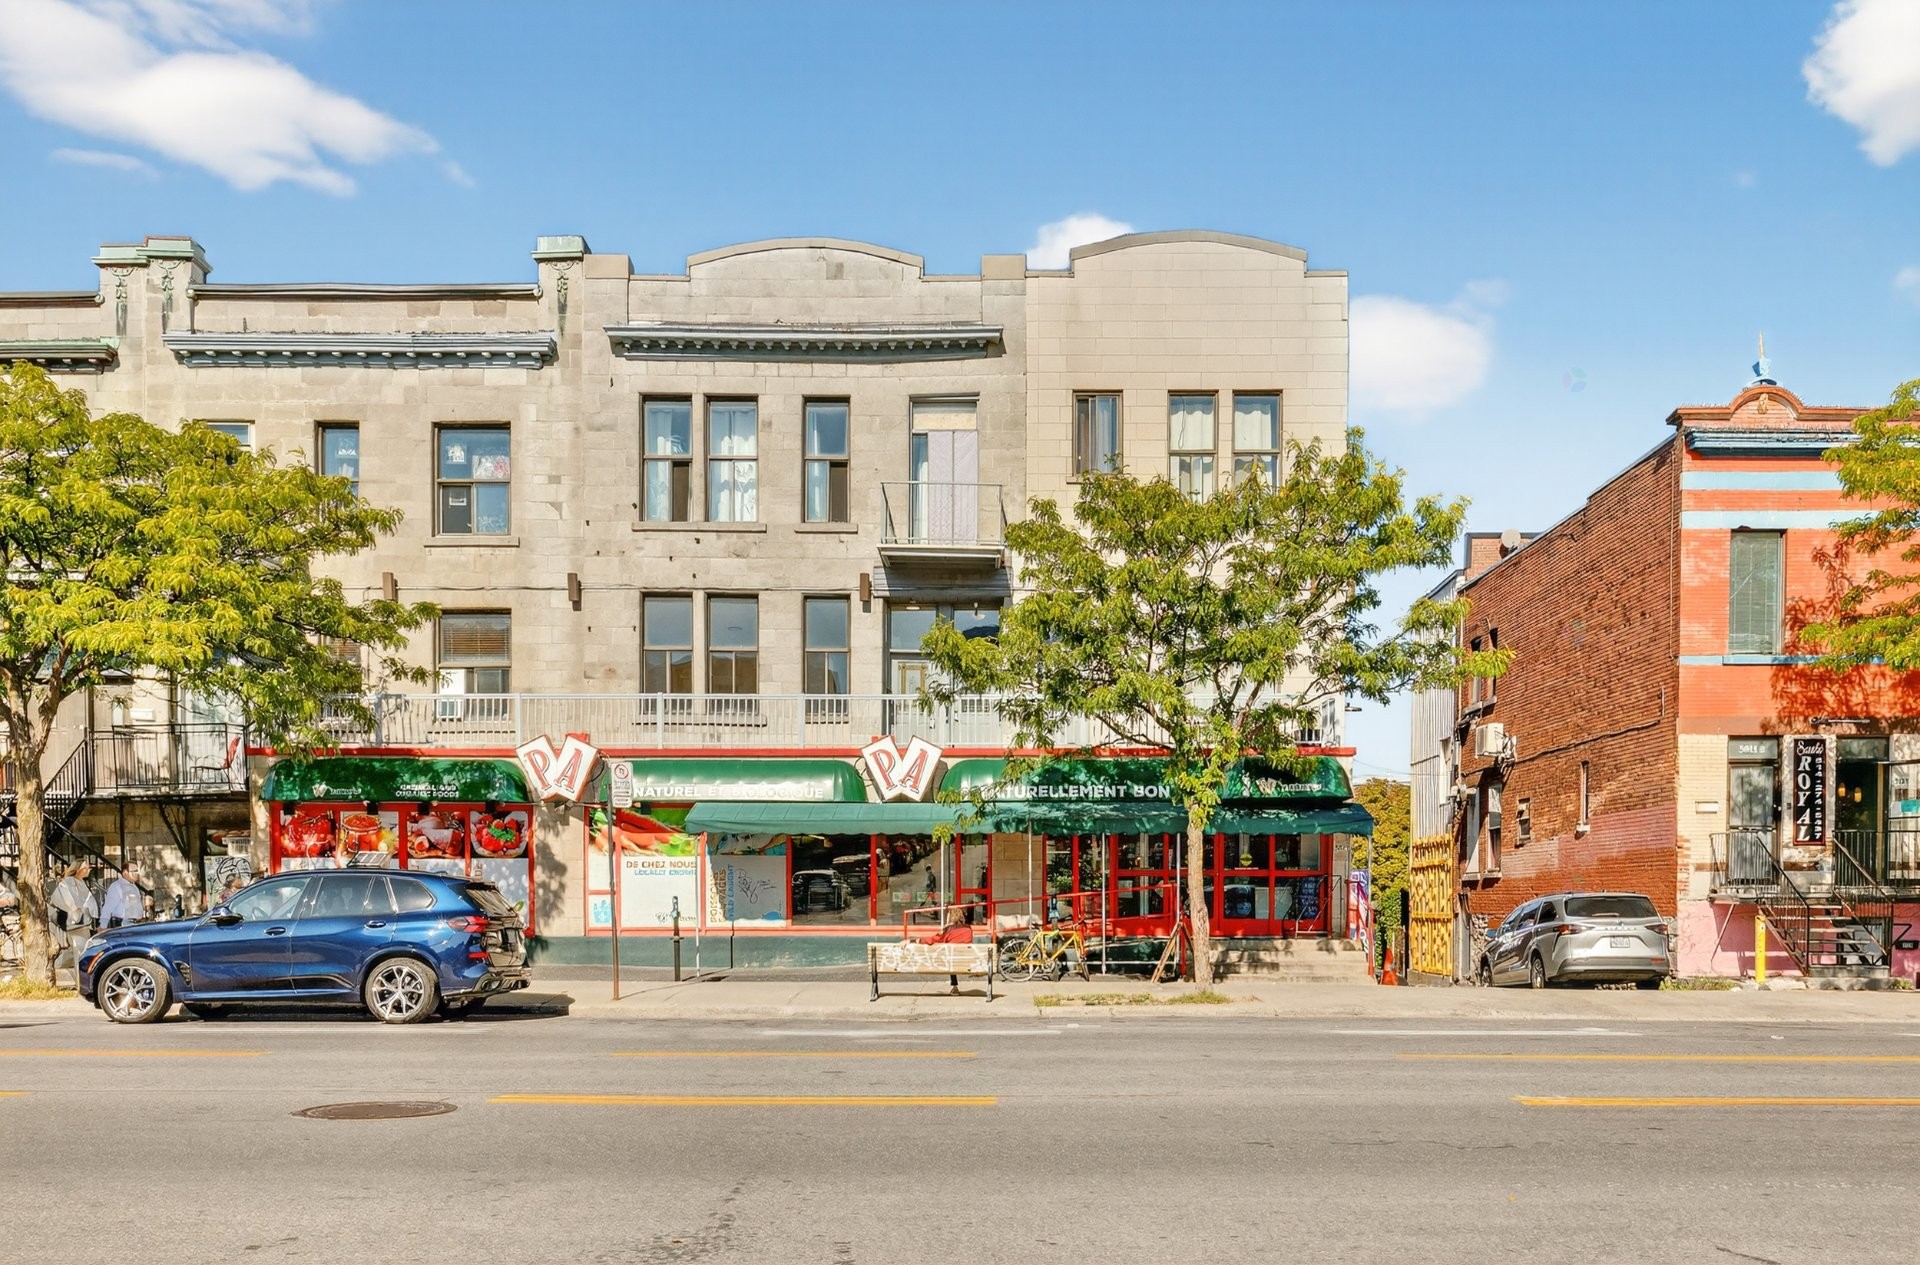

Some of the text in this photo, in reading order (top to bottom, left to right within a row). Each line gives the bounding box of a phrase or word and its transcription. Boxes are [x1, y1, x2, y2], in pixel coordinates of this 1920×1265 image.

[633, 786, 700, 798] NATUREL
[1133, 784, 1171, 799] BON
[1796, 755, 1812, 841] ROYAL
[641, 861, 666, 869] CHEZ
[669, 861, 697, 869] NOUS
